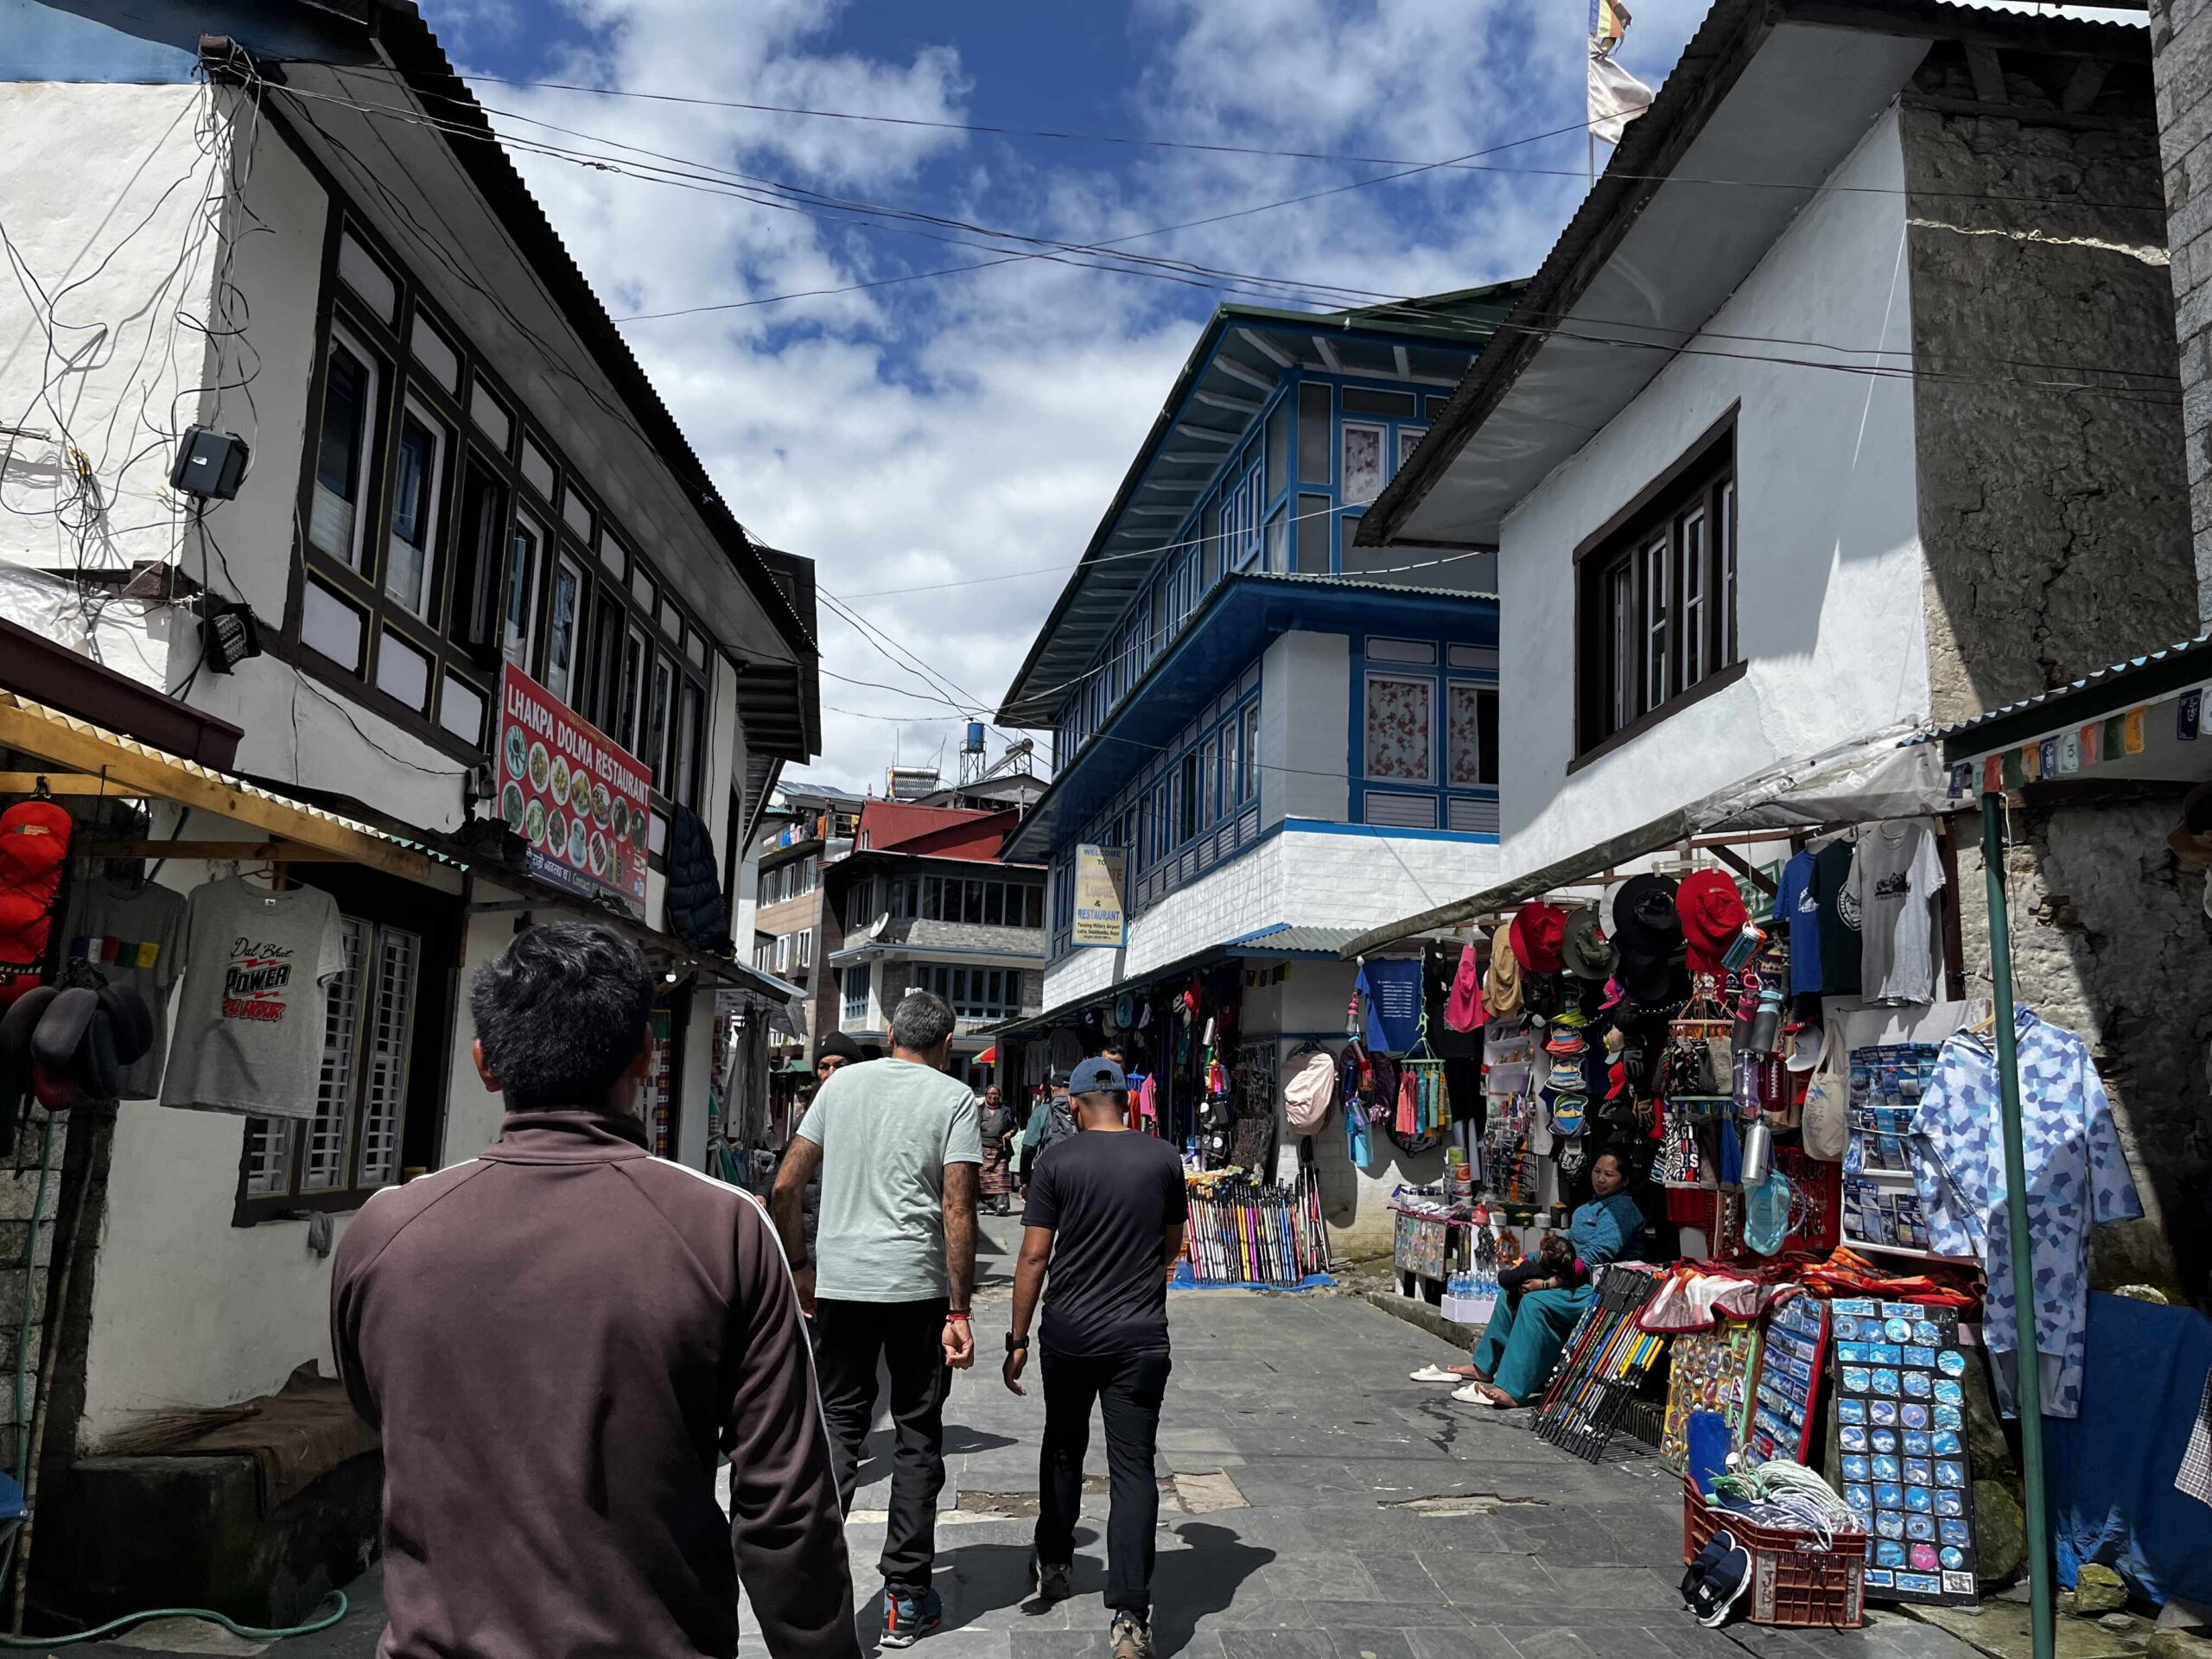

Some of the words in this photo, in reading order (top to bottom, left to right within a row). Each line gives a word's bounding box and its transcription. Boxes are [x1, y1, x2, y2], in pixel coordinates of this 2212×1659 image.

[507, 683, 554, 742] LHAKPA
[556, 720, 593, 770] DOLMA
[595, 747, 650, 807] RESTAURANT
[1084, 849, 1121, 857] WELCOME
[1077, 908, 1121, 921] RESTAURANT
[230, 937, 262, 960] Dal
[259, 944, 295, 960] Bhat
[224, 964, 291, 998] POWER
[222, 999, 241, 1018] 24
[239, 1000, 287, 1022] HOUR
